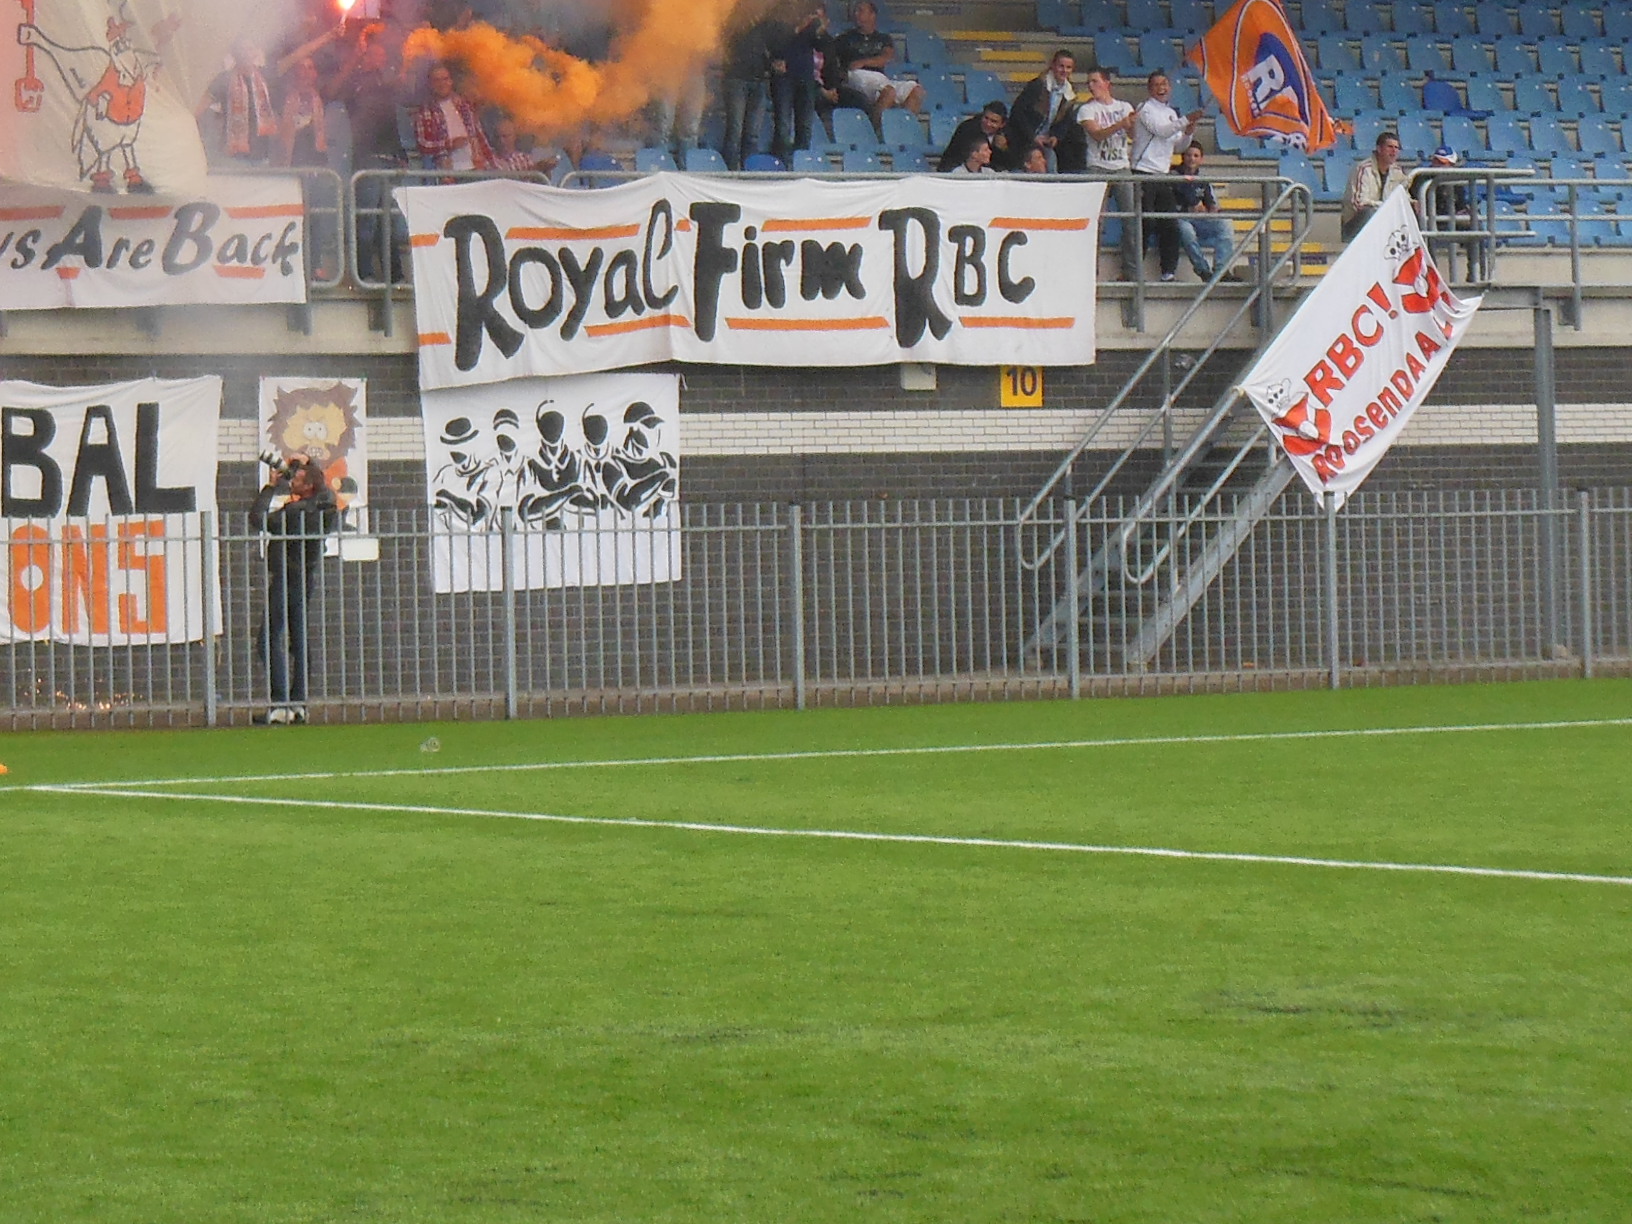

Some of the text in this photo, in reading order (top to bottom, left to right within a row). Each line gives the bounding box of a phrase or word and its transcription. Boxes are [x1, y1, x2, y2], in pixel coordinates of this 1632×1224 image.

[42, 205, 154, 270] Are
[161, 201, 300, 277] Back
[690, 202, 867, 342] Firm
[878, 207, 1036, 348] RBC
[1006, 365, 1038, 396] 10
[1303, 281, 1399, 408] RBC!
[7, 519, 168, 635] ONS
